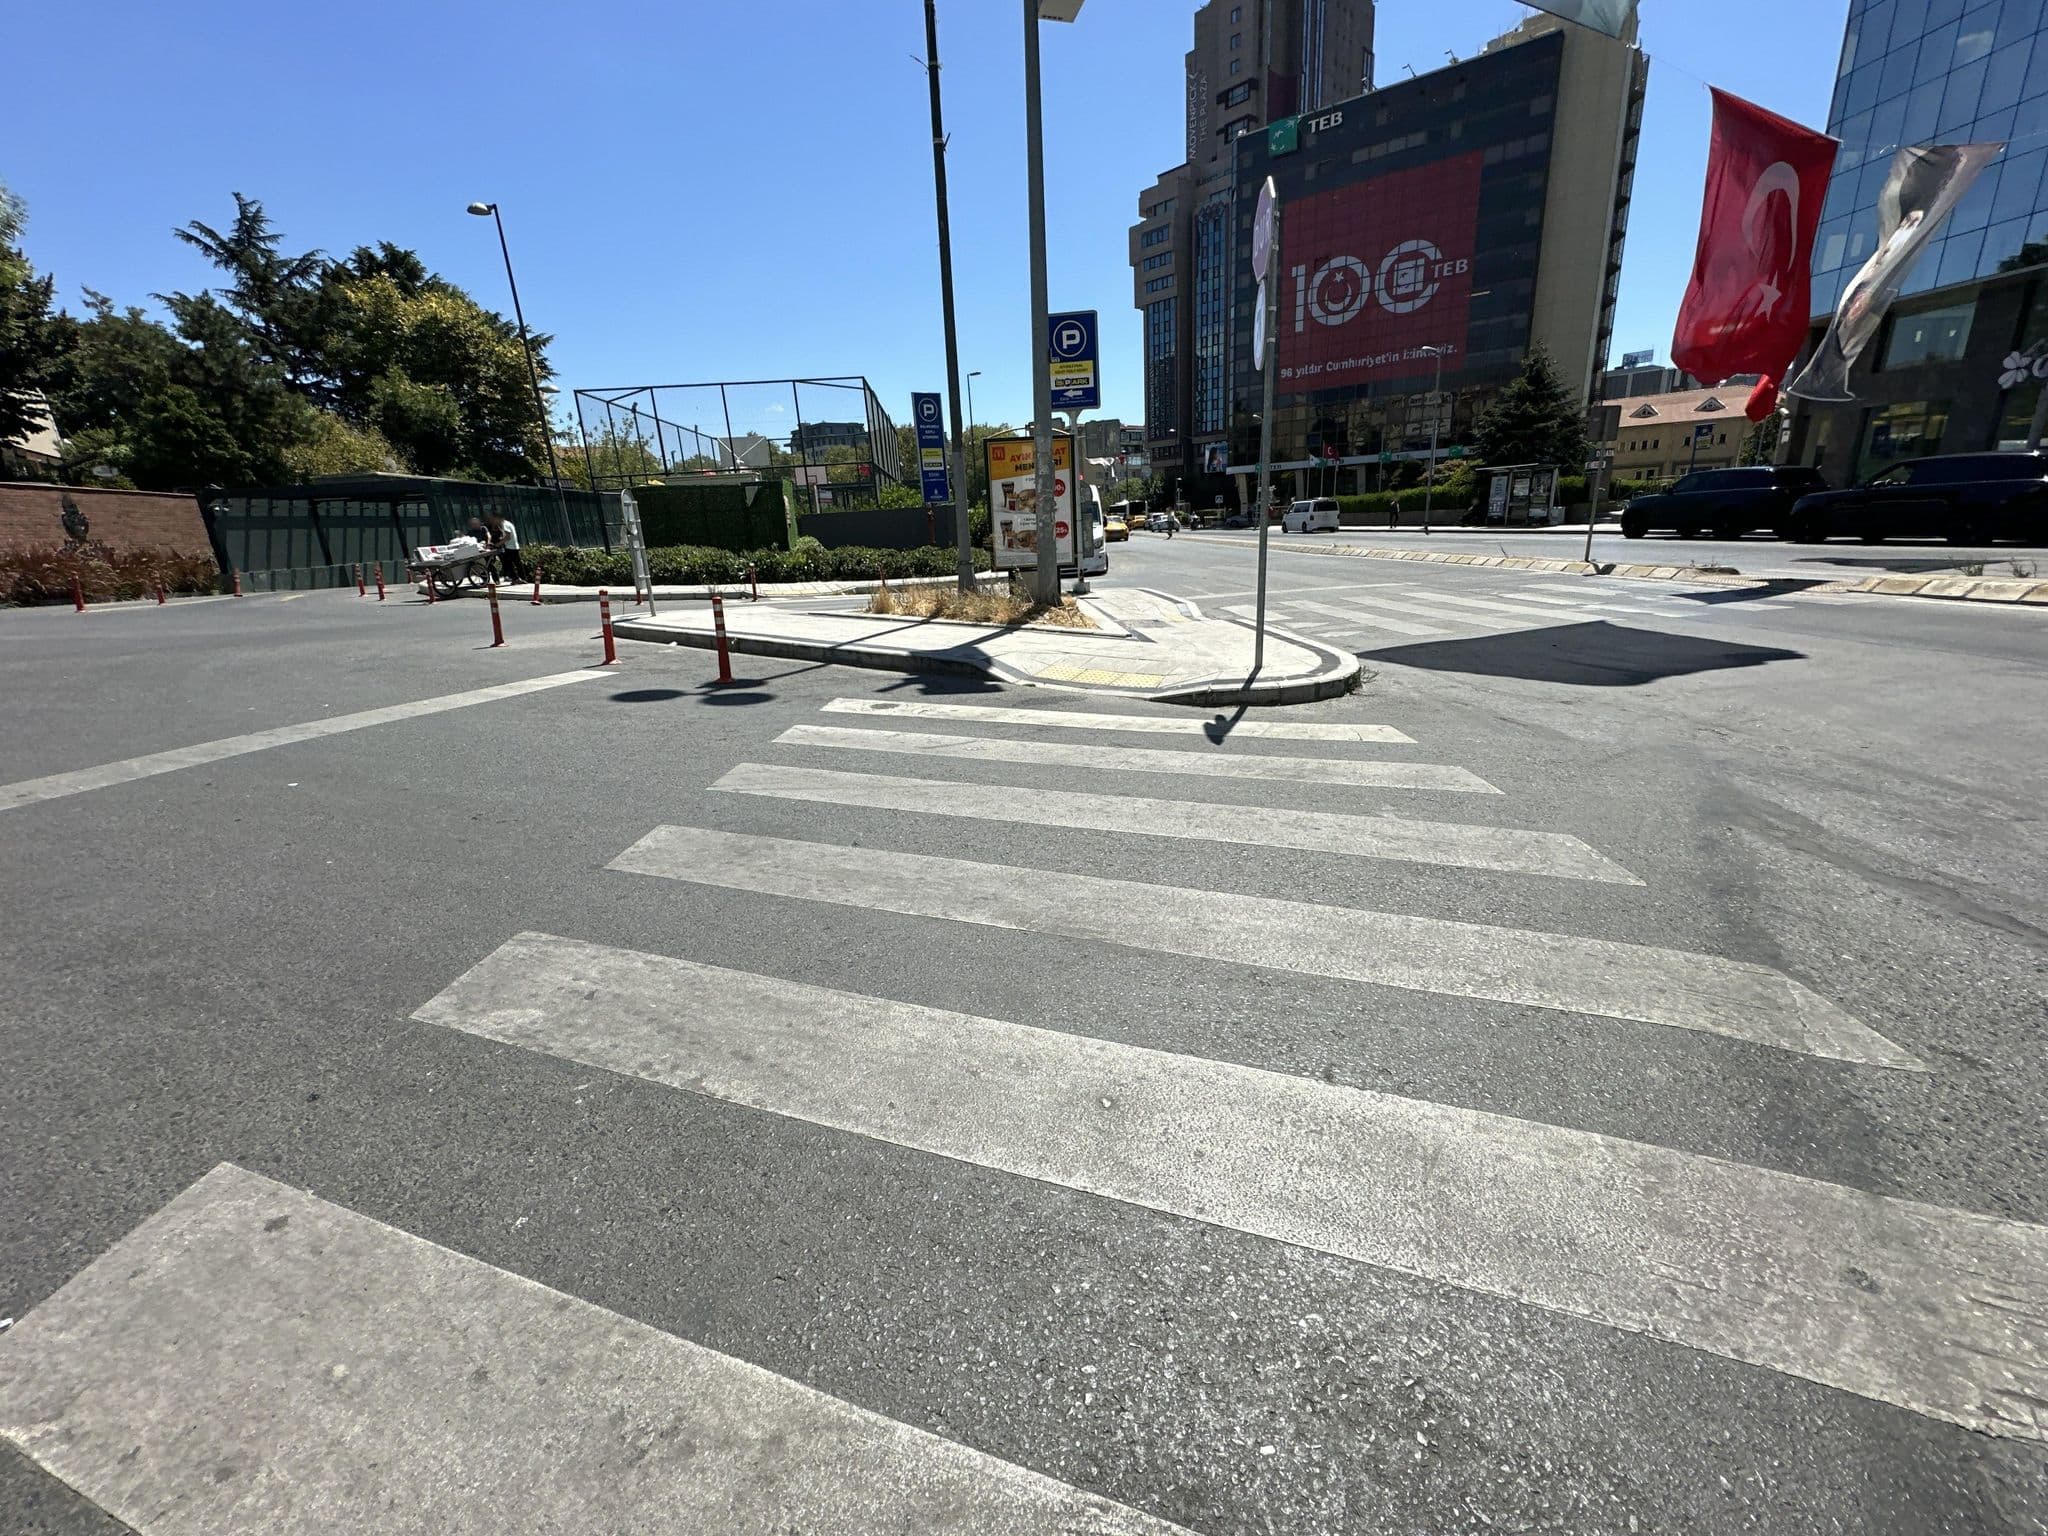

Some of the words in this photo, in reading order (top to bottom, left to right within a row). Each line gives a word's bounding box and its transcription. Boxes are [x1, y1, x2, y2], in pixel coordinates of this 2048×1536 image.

[1199, 76, 1209, 116] PLAZA
[1199, 117, 1209, 143] THE
[1308, 111, 1343, 133] TEB
[1431, 258, 1469, 279] TEB
[1062, 329, 1080, 349] P
[1280, 367, 1293, 378] 96
[1295, 363, 1323, 379] yıldır
[1326, 352, 1400, 372] Cumhuriyet'in
[923, 404, 934, 416] P
